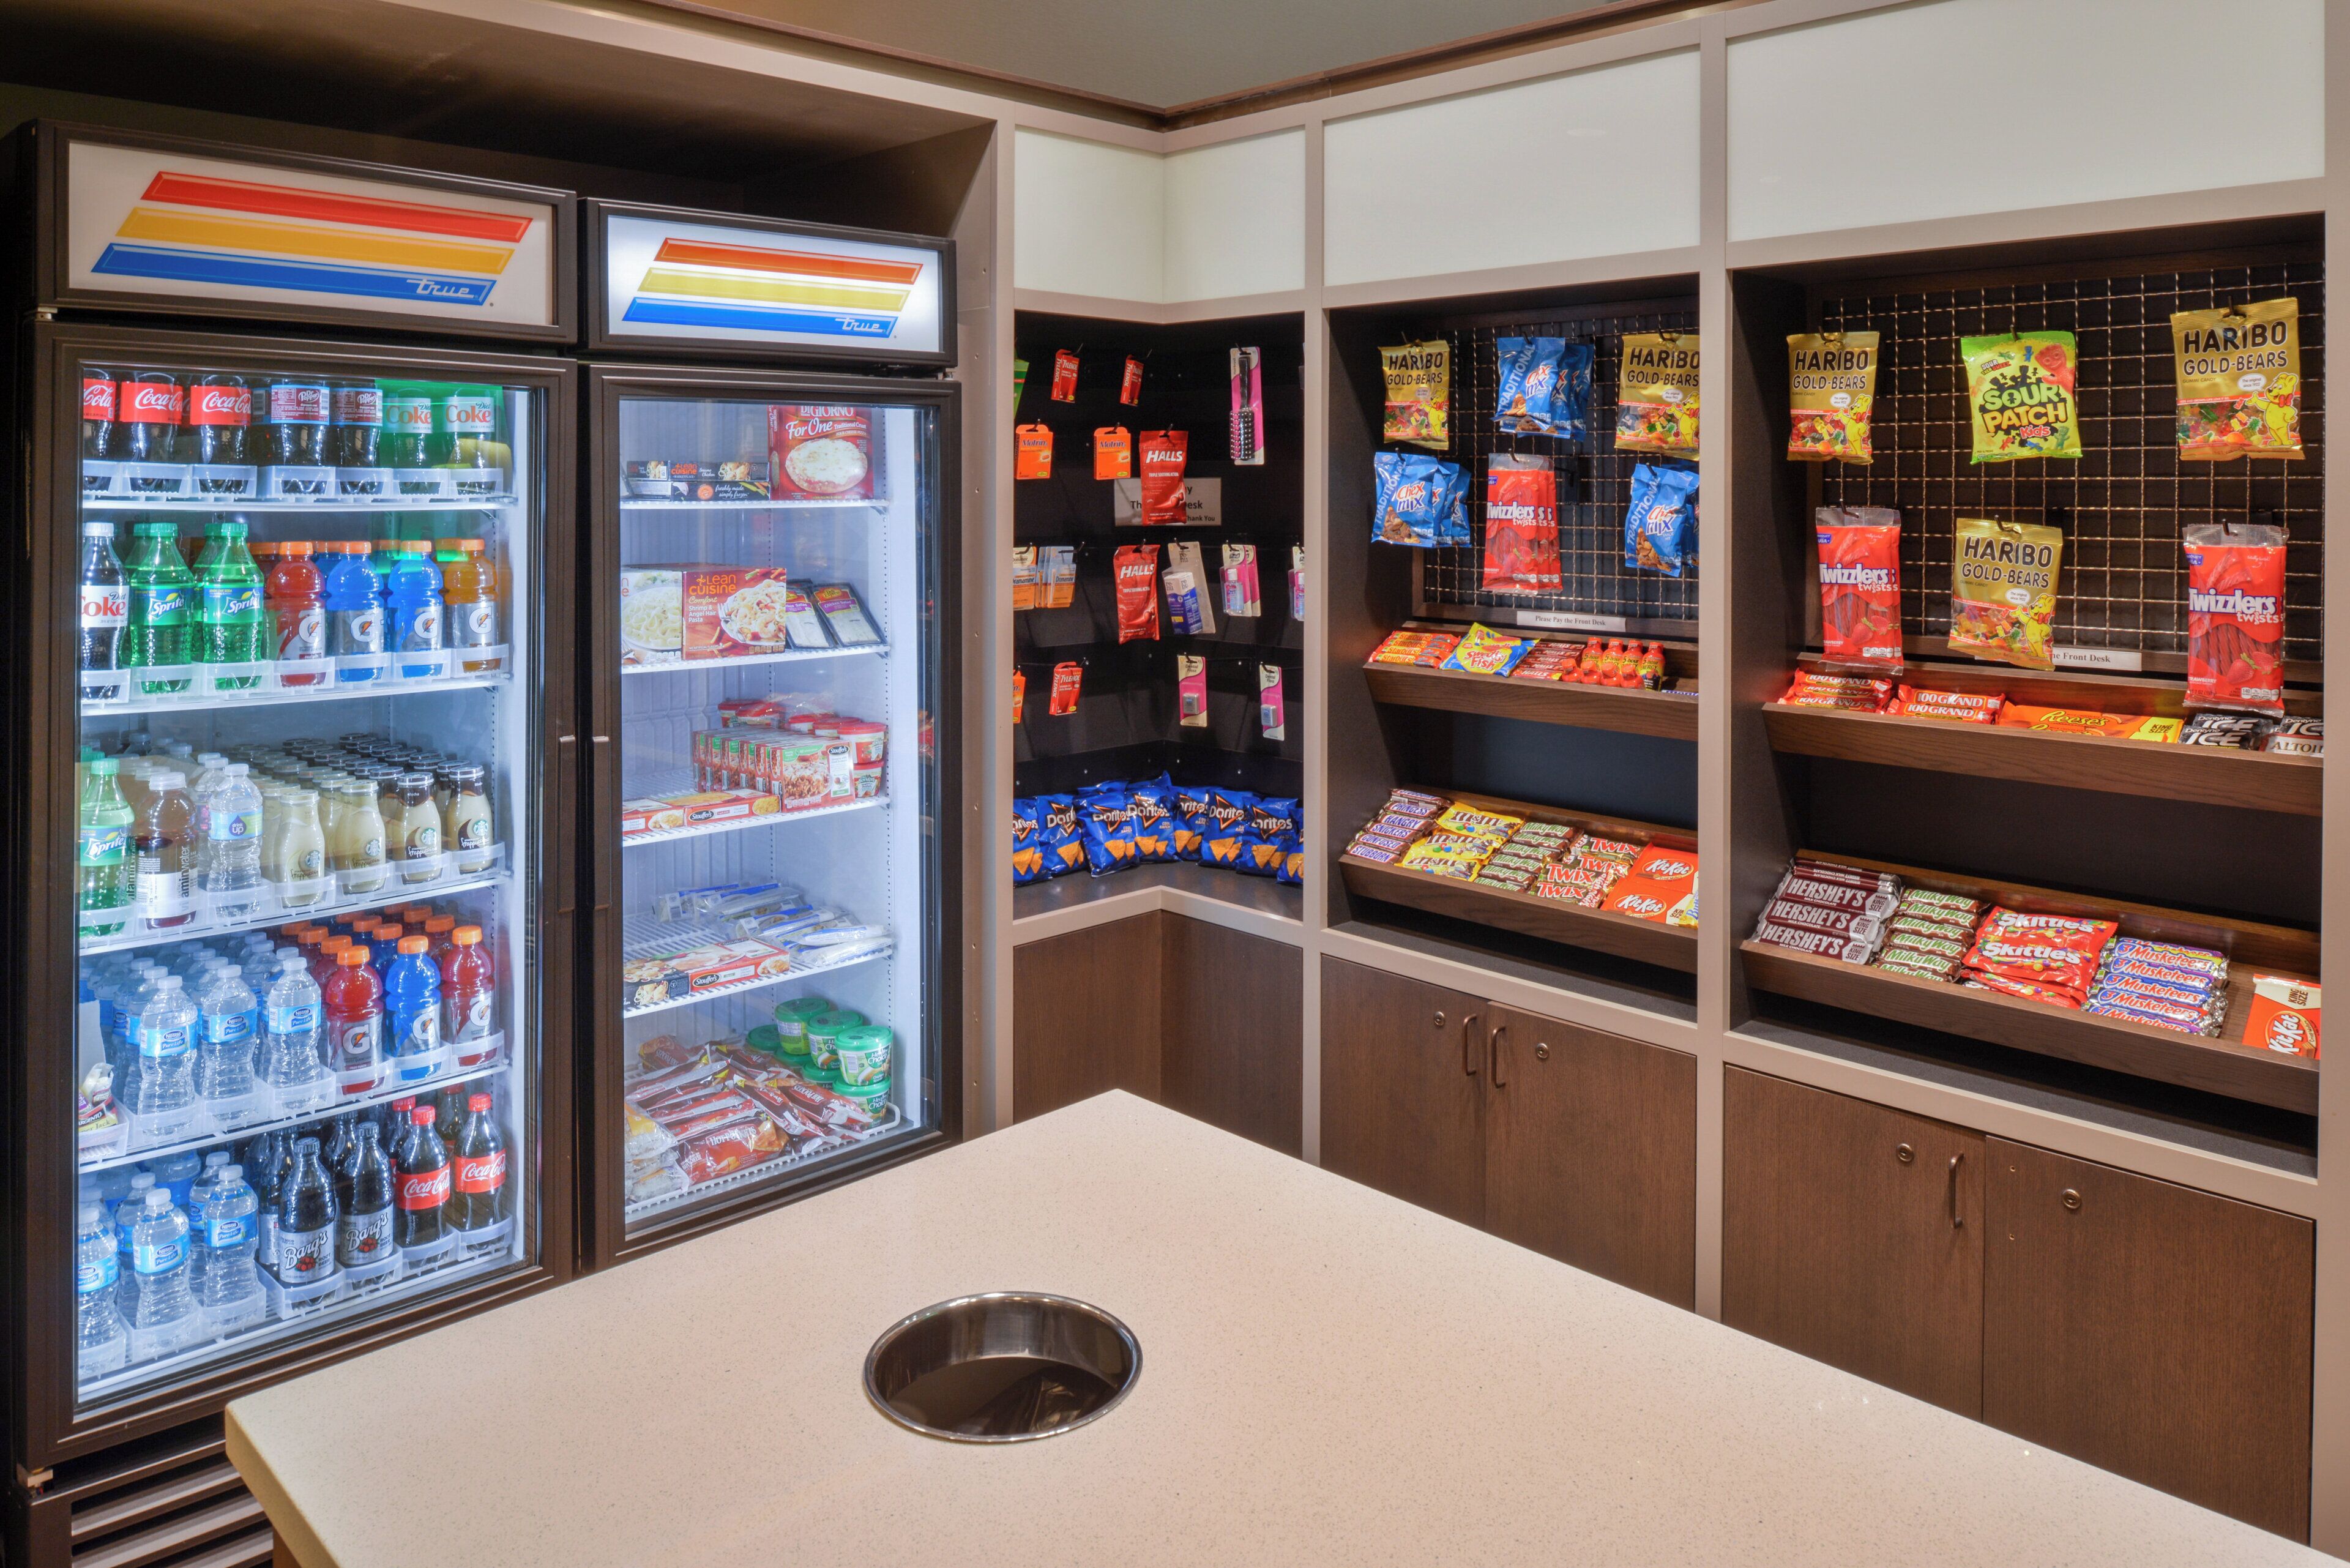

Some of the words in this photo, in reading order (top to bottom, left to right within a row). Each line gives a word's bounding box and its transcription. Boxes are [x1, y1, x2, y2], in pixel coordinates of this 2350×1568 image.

[2183, 320, 2287, 355] HARIBO
[1062, 359, 1078, 370] TYLENOL
[1389, 352, 1443, 370] HARIBO
[1629, 348, 1699, 370] HARIBO
[1794, 349, 1870, 371] HARIBO
[1982, 359, 1999, 370] SOUR
[2183, 350, 2288, 376] GOLD-BEARS
[1387, 372, 1442, 385] GOLD-BEARS
[1498, 344, 1535, 409] TRADITIONAL
[1627, 369, 1698, 386] GOLD-BEARS
[1792, 375, 1867, 390] GOLD-BEARS
[202, 391, 252, 413] Coca-Col
[1983, 385, 2061, 411] SOUR
[386, 405, 431, 424] Coke
[446, 405, 492, 423] Coke
[1983, 401, 2068, 433] PATCH
[785, 420, 807, 439] For
[808, 417, 833, 436] One
[2020, 425, 2052, 438] Kids
[1146, 450, 1183, 463] HALLS
[715, 484, 731, 493] freshly
[1375, 460, 1405, 525] TRADITIONAL
[1397, 482, 1425, 499] Chex
[1486, 501, 1534, 520] Twizzlers
[1627, 476, 1661, 546] TRADITIONAL
[1513, 518, 1537, 527] twists
[1963, 536, 2053, 568] HARIBO
[1120, 564, 1155, 579] HALLS
[1819, 563, 1889, 585] Twizzlers
[1962, 562, 2050, 589] GOLD-BEARS
[1858, 582, 1890, 592] twists
[153, 596, 184, 614] Sprite
[227, 595, 258, 614] Sprite
[2189, 588, 2276, 614] Twizzlers
[414, 612, 438, 639] G
[469, 608, 492, 635] G
[1535, 616, 1551, 624] Please
[1553, 616, 1563, 626] Pay
[2237, 612, 2279, 624] twists
[299, 614, 322, 643] G
[351, 614, 376, 643] G
[1470, 657, 1494, 670] Fish
[2063, 652, 2087, 662] Front
[2089, 653, 2111, 663] Desk
[1061, 674, 1080, 684] TYLENOL
[1809, 674, 1830, 683] 100
[1830, 676, 1871, 686] GRAND
[1917, 692, 1938, 703] 100
[1939, 694, 1983, 707] GRAND
[1907, 704, 1928, 713] 100
[1928, 705, 1974, 718] GRAND
[2040, 711, 2109, 726] Reese's
[2184, 732, 2248, 747] ICE
[691, 811, 713, 821] Stouffer's
[1127, 804, 1170, 817] Doritos
[1390, 802, 1430, 816] PRINCESS
[1371, 823, 1411, 838] SNICKERS
[1384, 815, 1420, 829] HANGRY
[90, 836, 126, 856] Sprite
[1361, 834, 1402, 849] CONFUSED
[1351, 845, 1392, 862] STUBBORN
[1787, 879, 1867, 907] HERSHEY'S
[1772, 900, 1851, 930] HERSHEY'S
[1997, 913, 2095, 933] Skittles
[1762, 924, 1844, 955] HERSHEY'S
[1845, 952, 1860, 961] SIZE
[1982, 942, 2082, 965] Skittles
[2132, 945, 2210, 971] Musketeers
[695, 975, 717, 985] Stouffer's
[2113, 958, 2124, 968] 3
[2126, 960, 2207, 986] Musketeers
[2107, 975, 2119, 984] 3
[2119, 976, 2201, 1003] Musketeers
[2288, 987, 2300, 1004] KING
[2298, 989, 2309, 1006] SIZE
[2102, 990, 2113, 999] 3
[2113, 991, 2195, 1019] Musketeers
[413, 1012, 435, 1040] G
[343, 1024, 370, 1055] G
[868, 1052, 887, 1064] Choice
[346, 1211, 389, 1252] Barq's
[379, 1234, 392, 1243] ROOT
[285, 1229, 329, 1269] Barq's
[318, 1253, 331, 1262] ROOT
[318, 1258, 330, 1267] BEER
